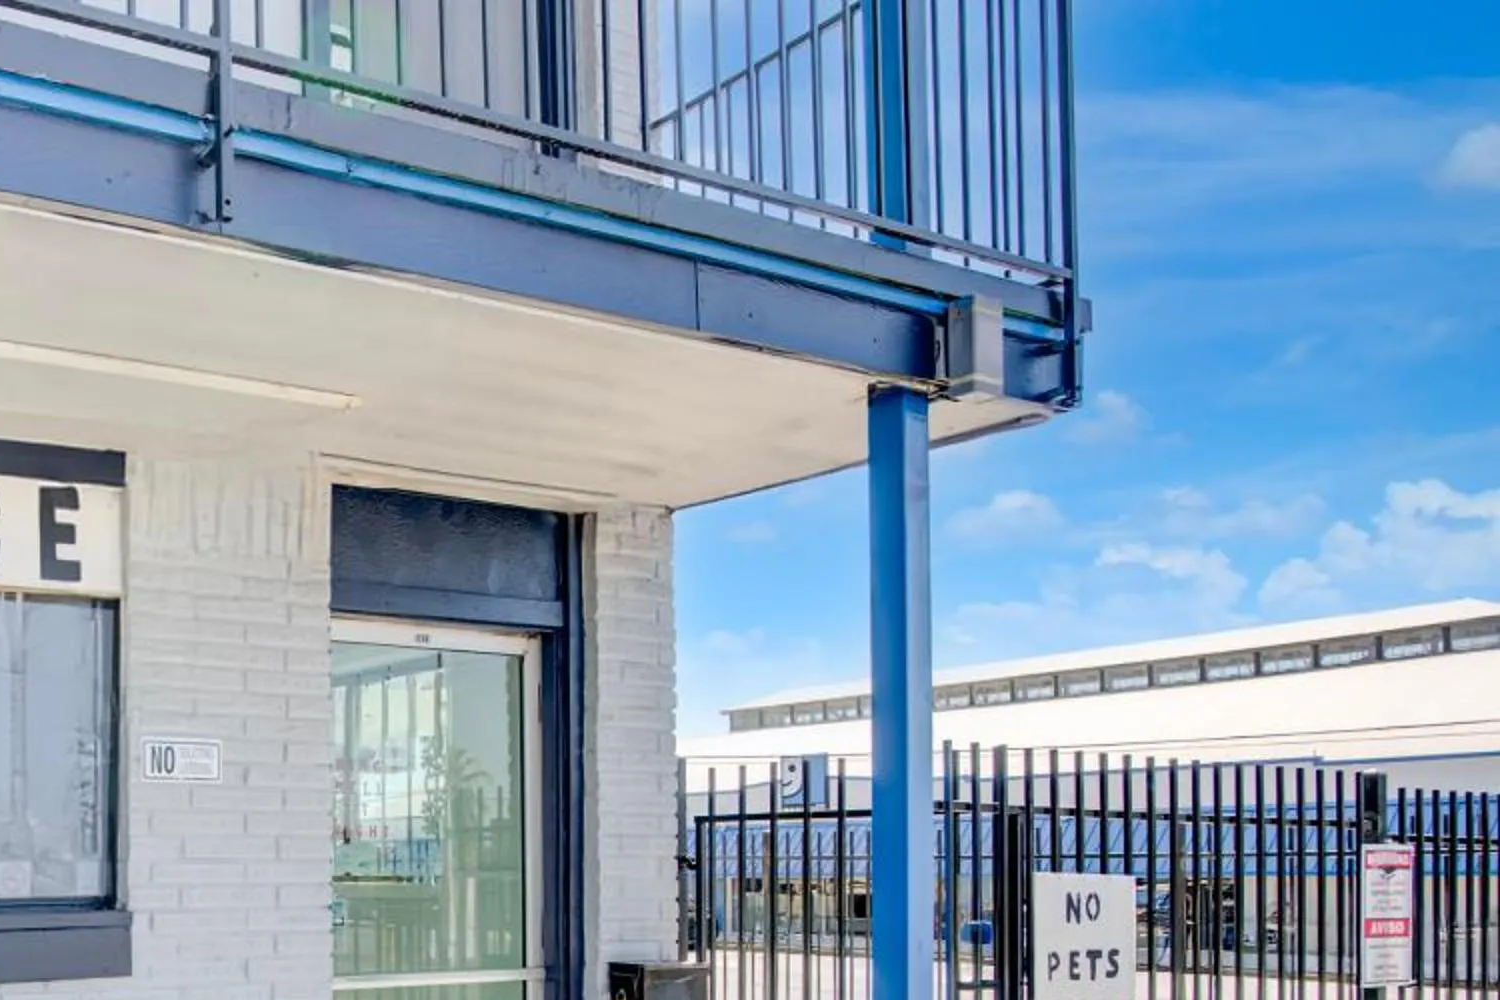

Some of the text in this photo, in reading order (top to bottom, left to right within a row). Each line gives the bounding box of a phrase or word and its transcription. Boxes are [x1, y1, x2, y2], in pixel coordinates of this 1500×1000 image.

[151, 746, 175, 774] NO
[1066, 892, 1100, 924] NO
[1047, 949, 1120, 981] PETS
